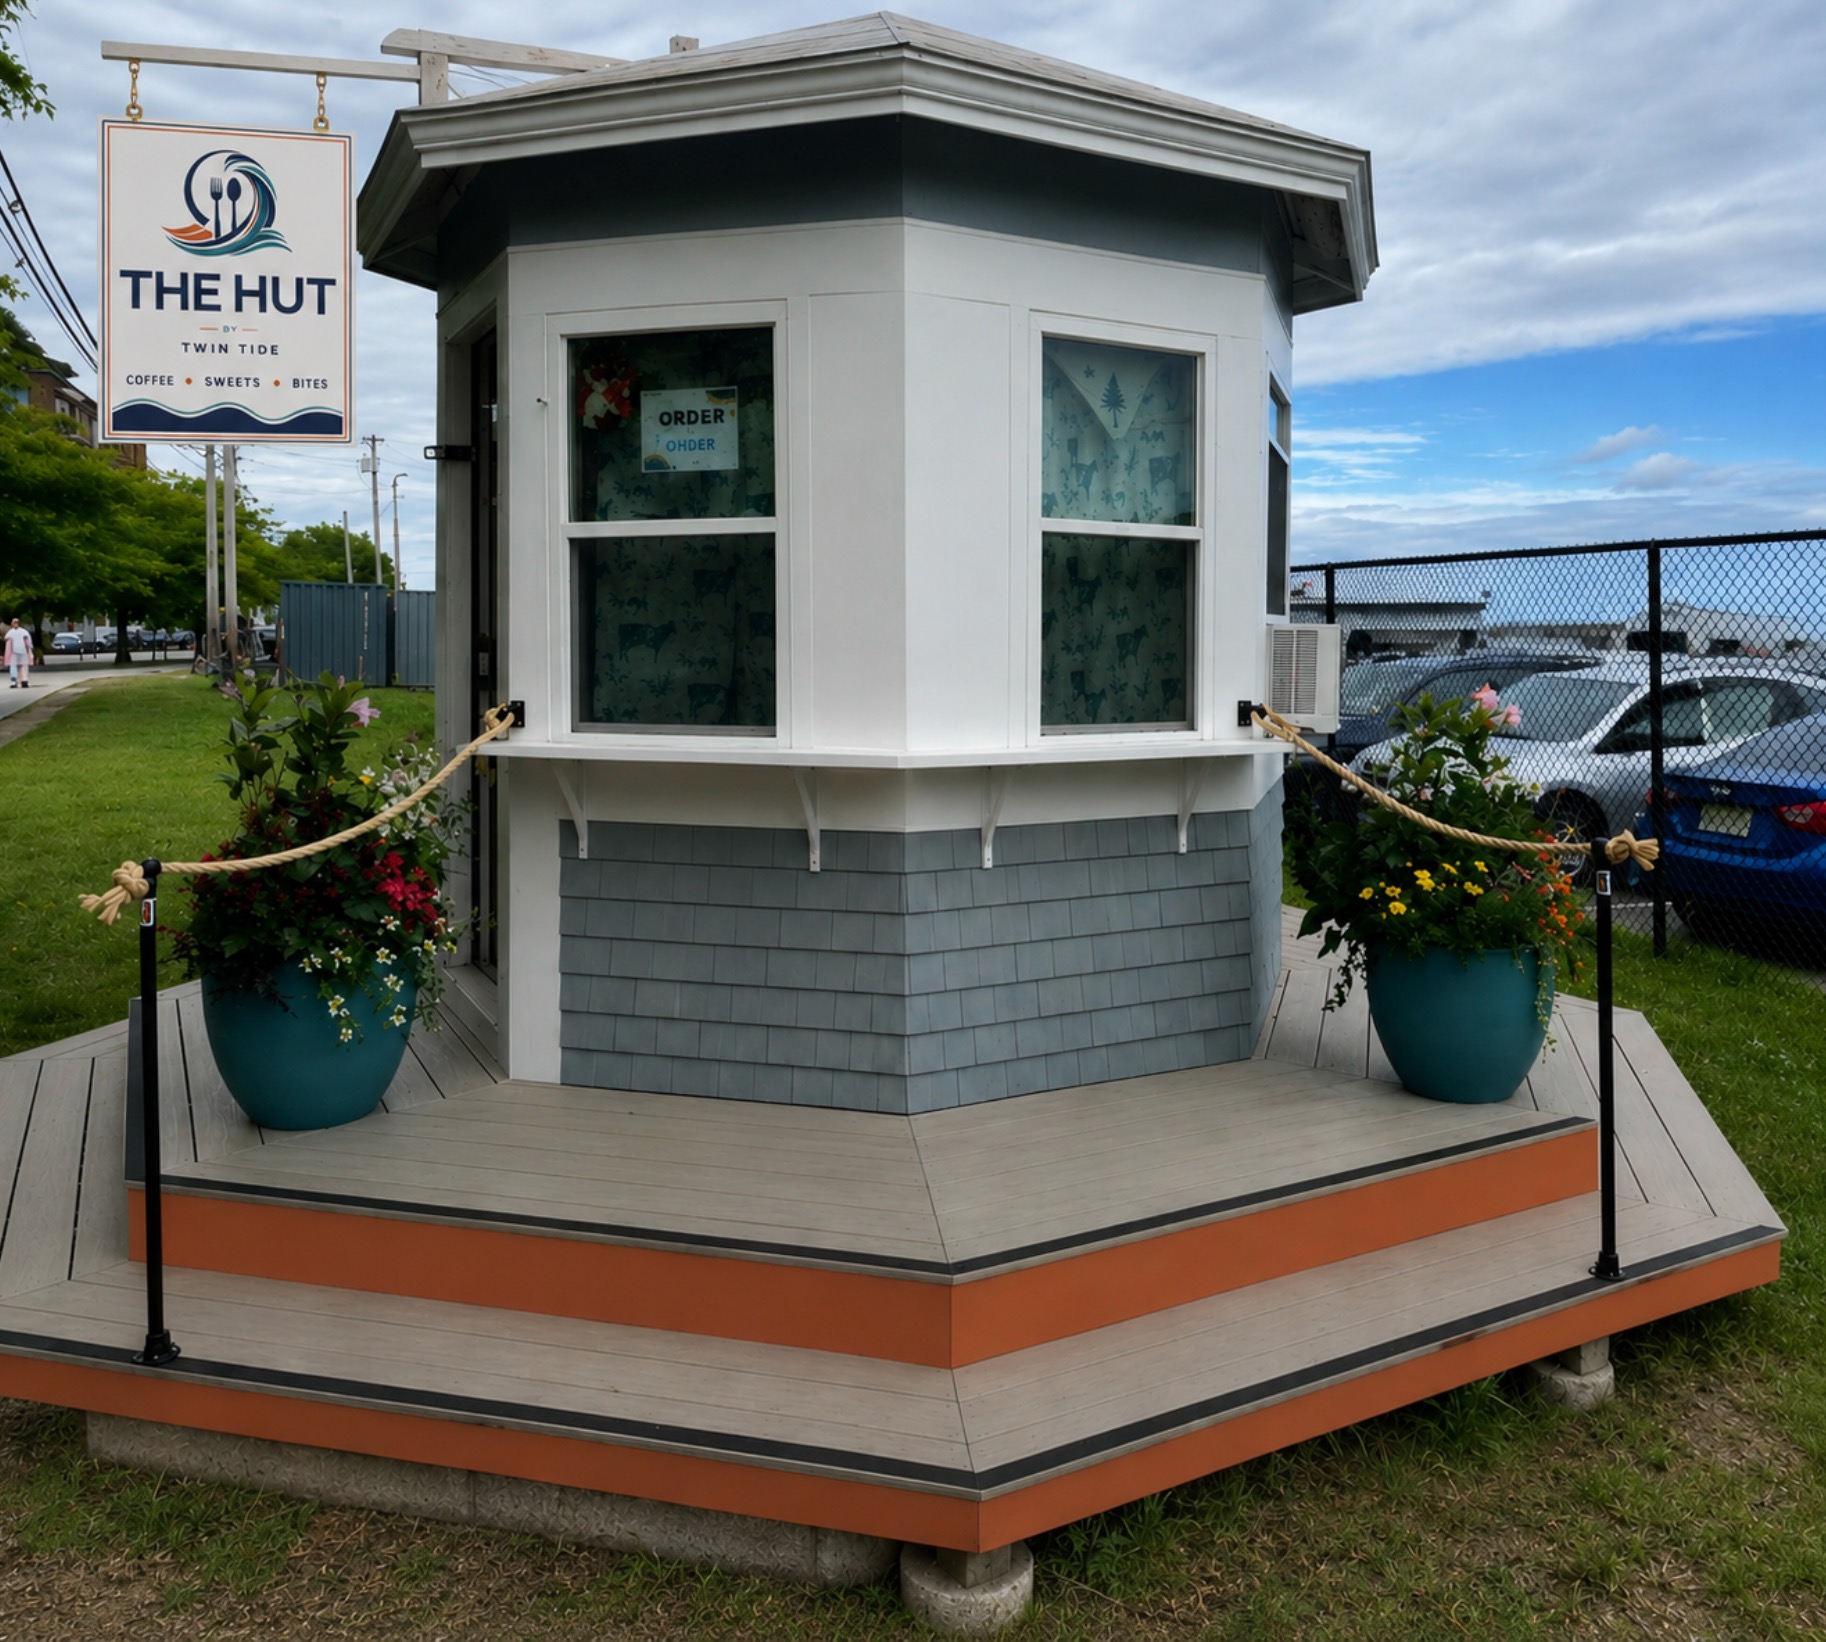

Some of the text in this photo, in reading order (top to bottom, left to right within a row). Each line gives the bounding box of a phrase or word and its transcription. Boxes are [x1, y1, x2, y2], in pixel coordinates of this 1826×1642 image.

[119, 269, 337, 315] THE HUT
[222, 325, 238, 333] BY
[181, 342, 279, 356] TWIN TIDE
[126, 374, 328, 390] COFFEE SWEETS BITES
[659, 408, 725, 427] ORDER
[666, 438, 716, 452] OHDER
